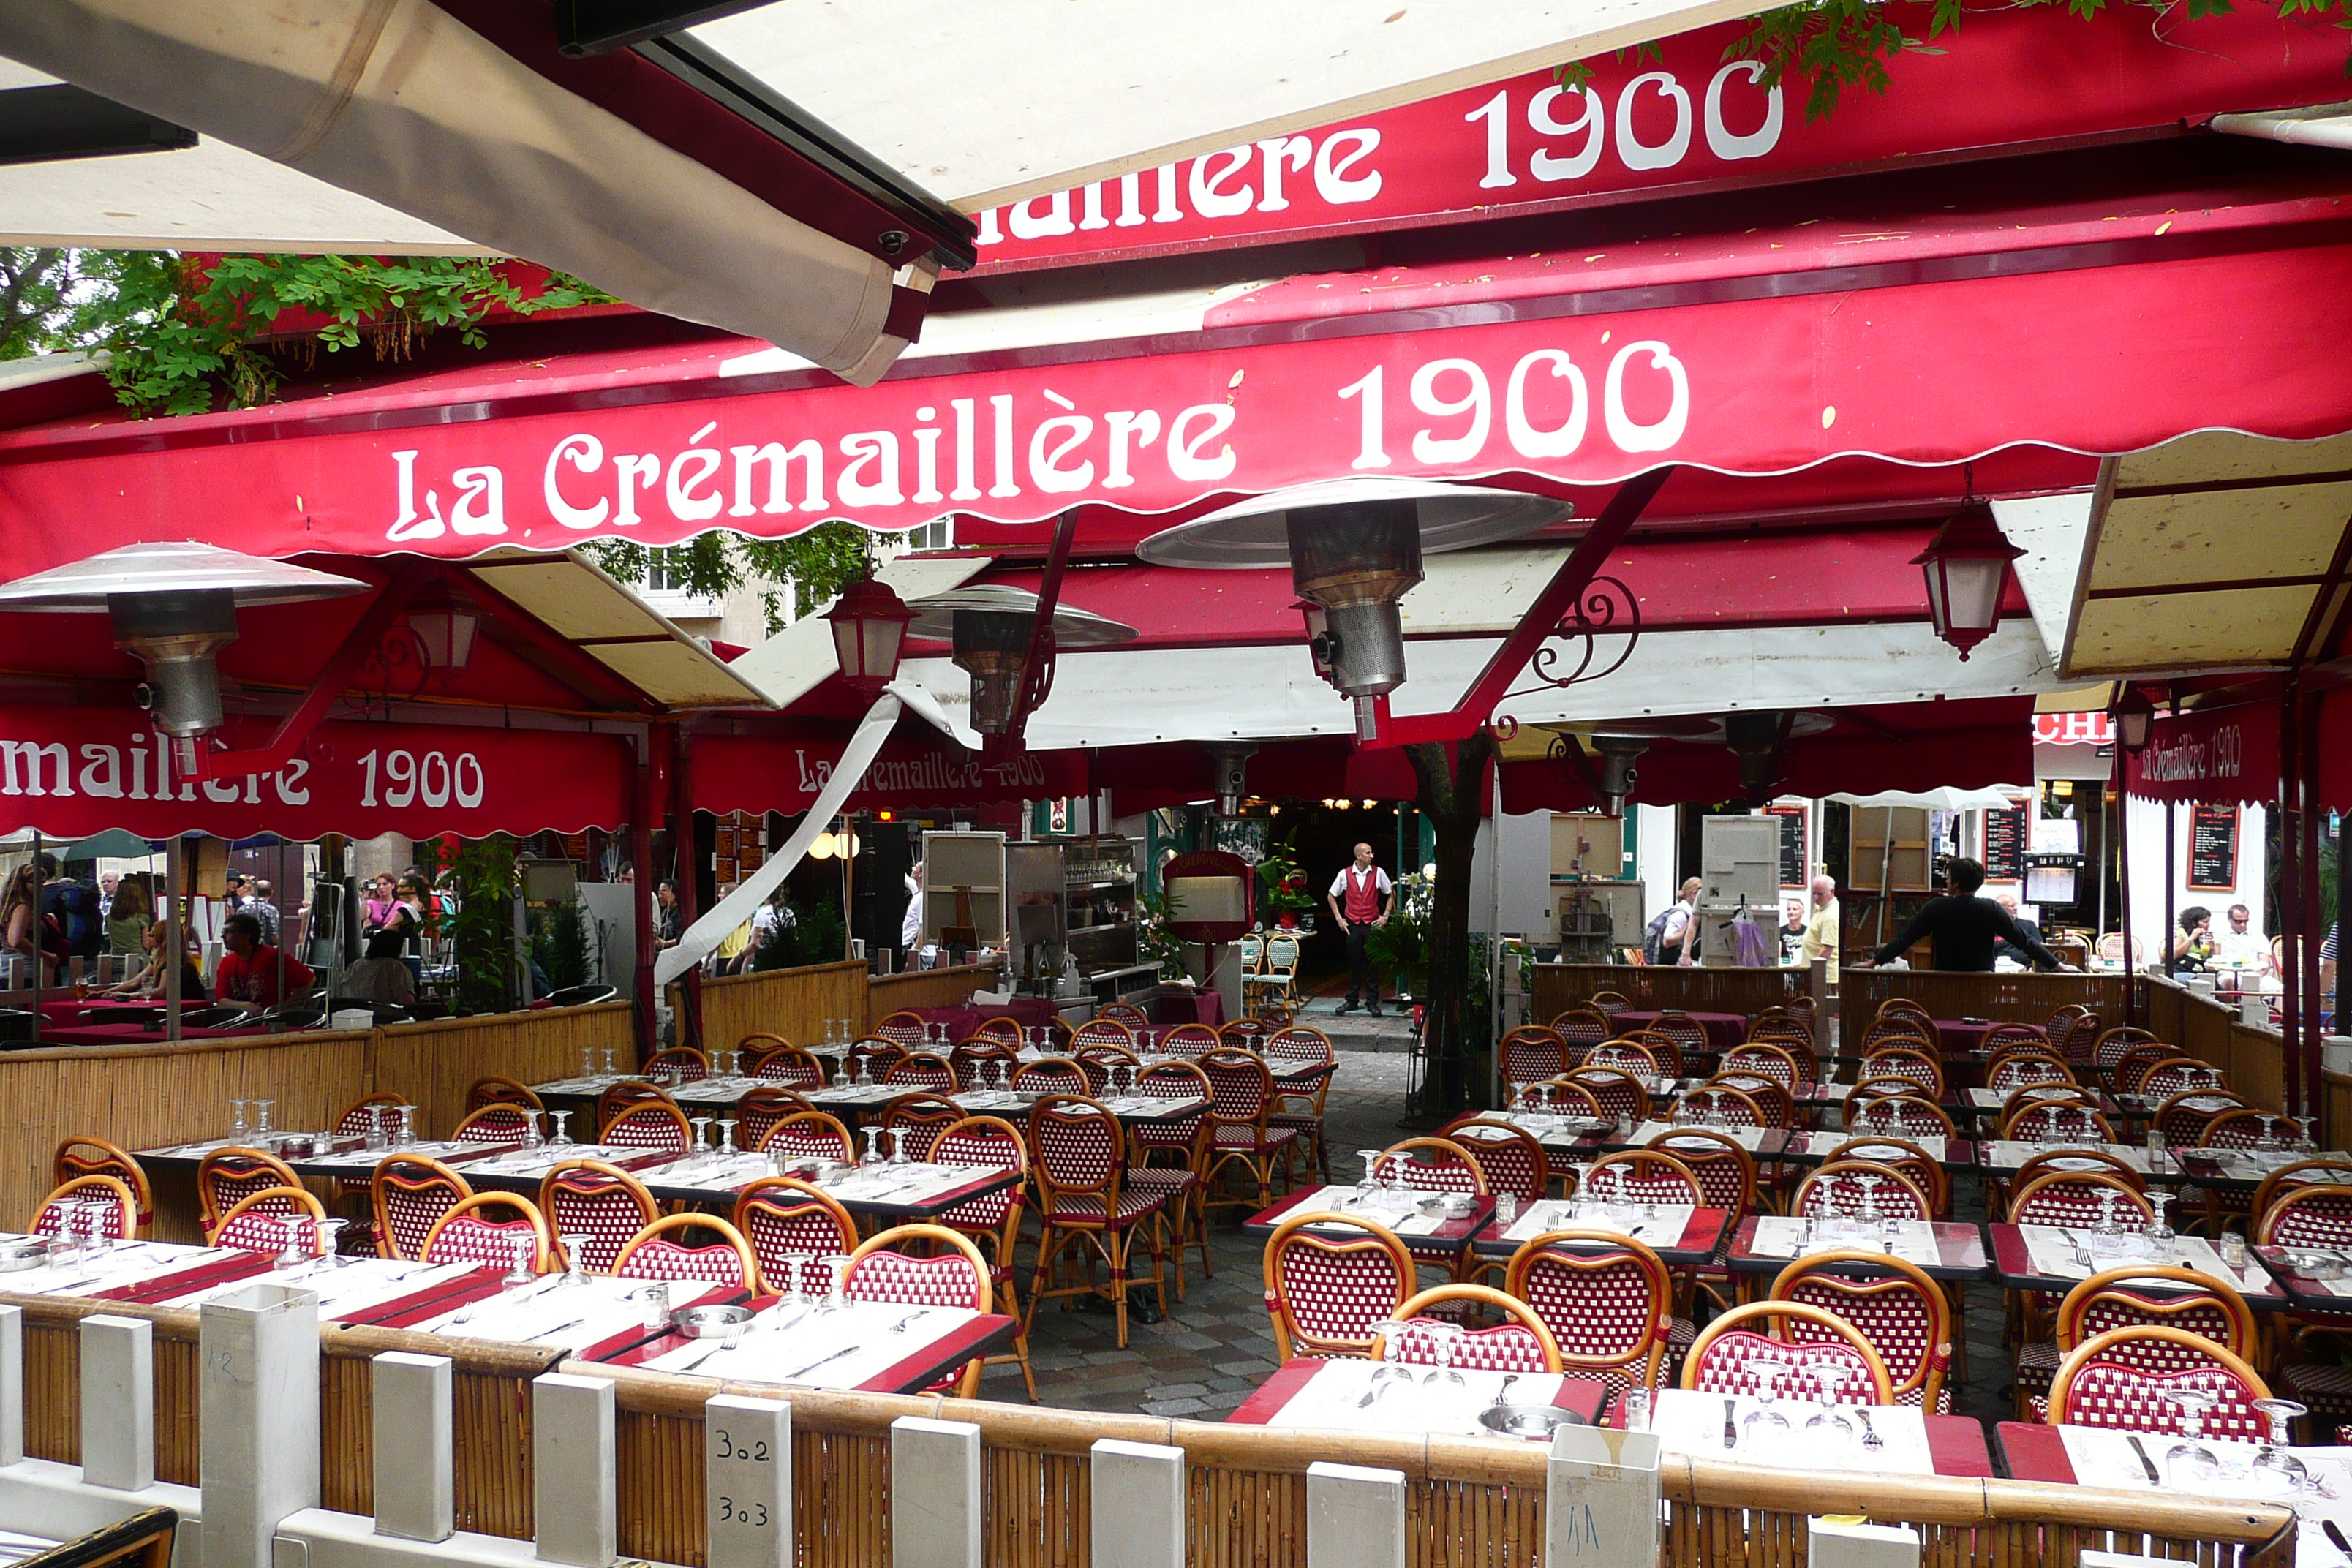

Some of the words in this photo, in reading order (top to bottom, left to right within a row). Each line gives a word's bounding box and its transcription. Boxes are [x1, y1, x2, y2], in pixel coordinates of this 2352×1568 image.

[1465, 59, 1783, 189] 1900
[385, 449, 510, 543] La
[543, 388, 1239, 527] Crémaillère
[1338, 339, 1689, 470] 1900
[357, 748, 484, 808] 1900
[795, 750, 835, 792] La
[2152, 732, 2206, 782] Crémaillère
[2210, 724, 2241, 777] 1900
[2039, 856, 2073, 865] MENU
[715, 1429, 770, 1462] 302
[718, 1496, 769, 1527] 303
